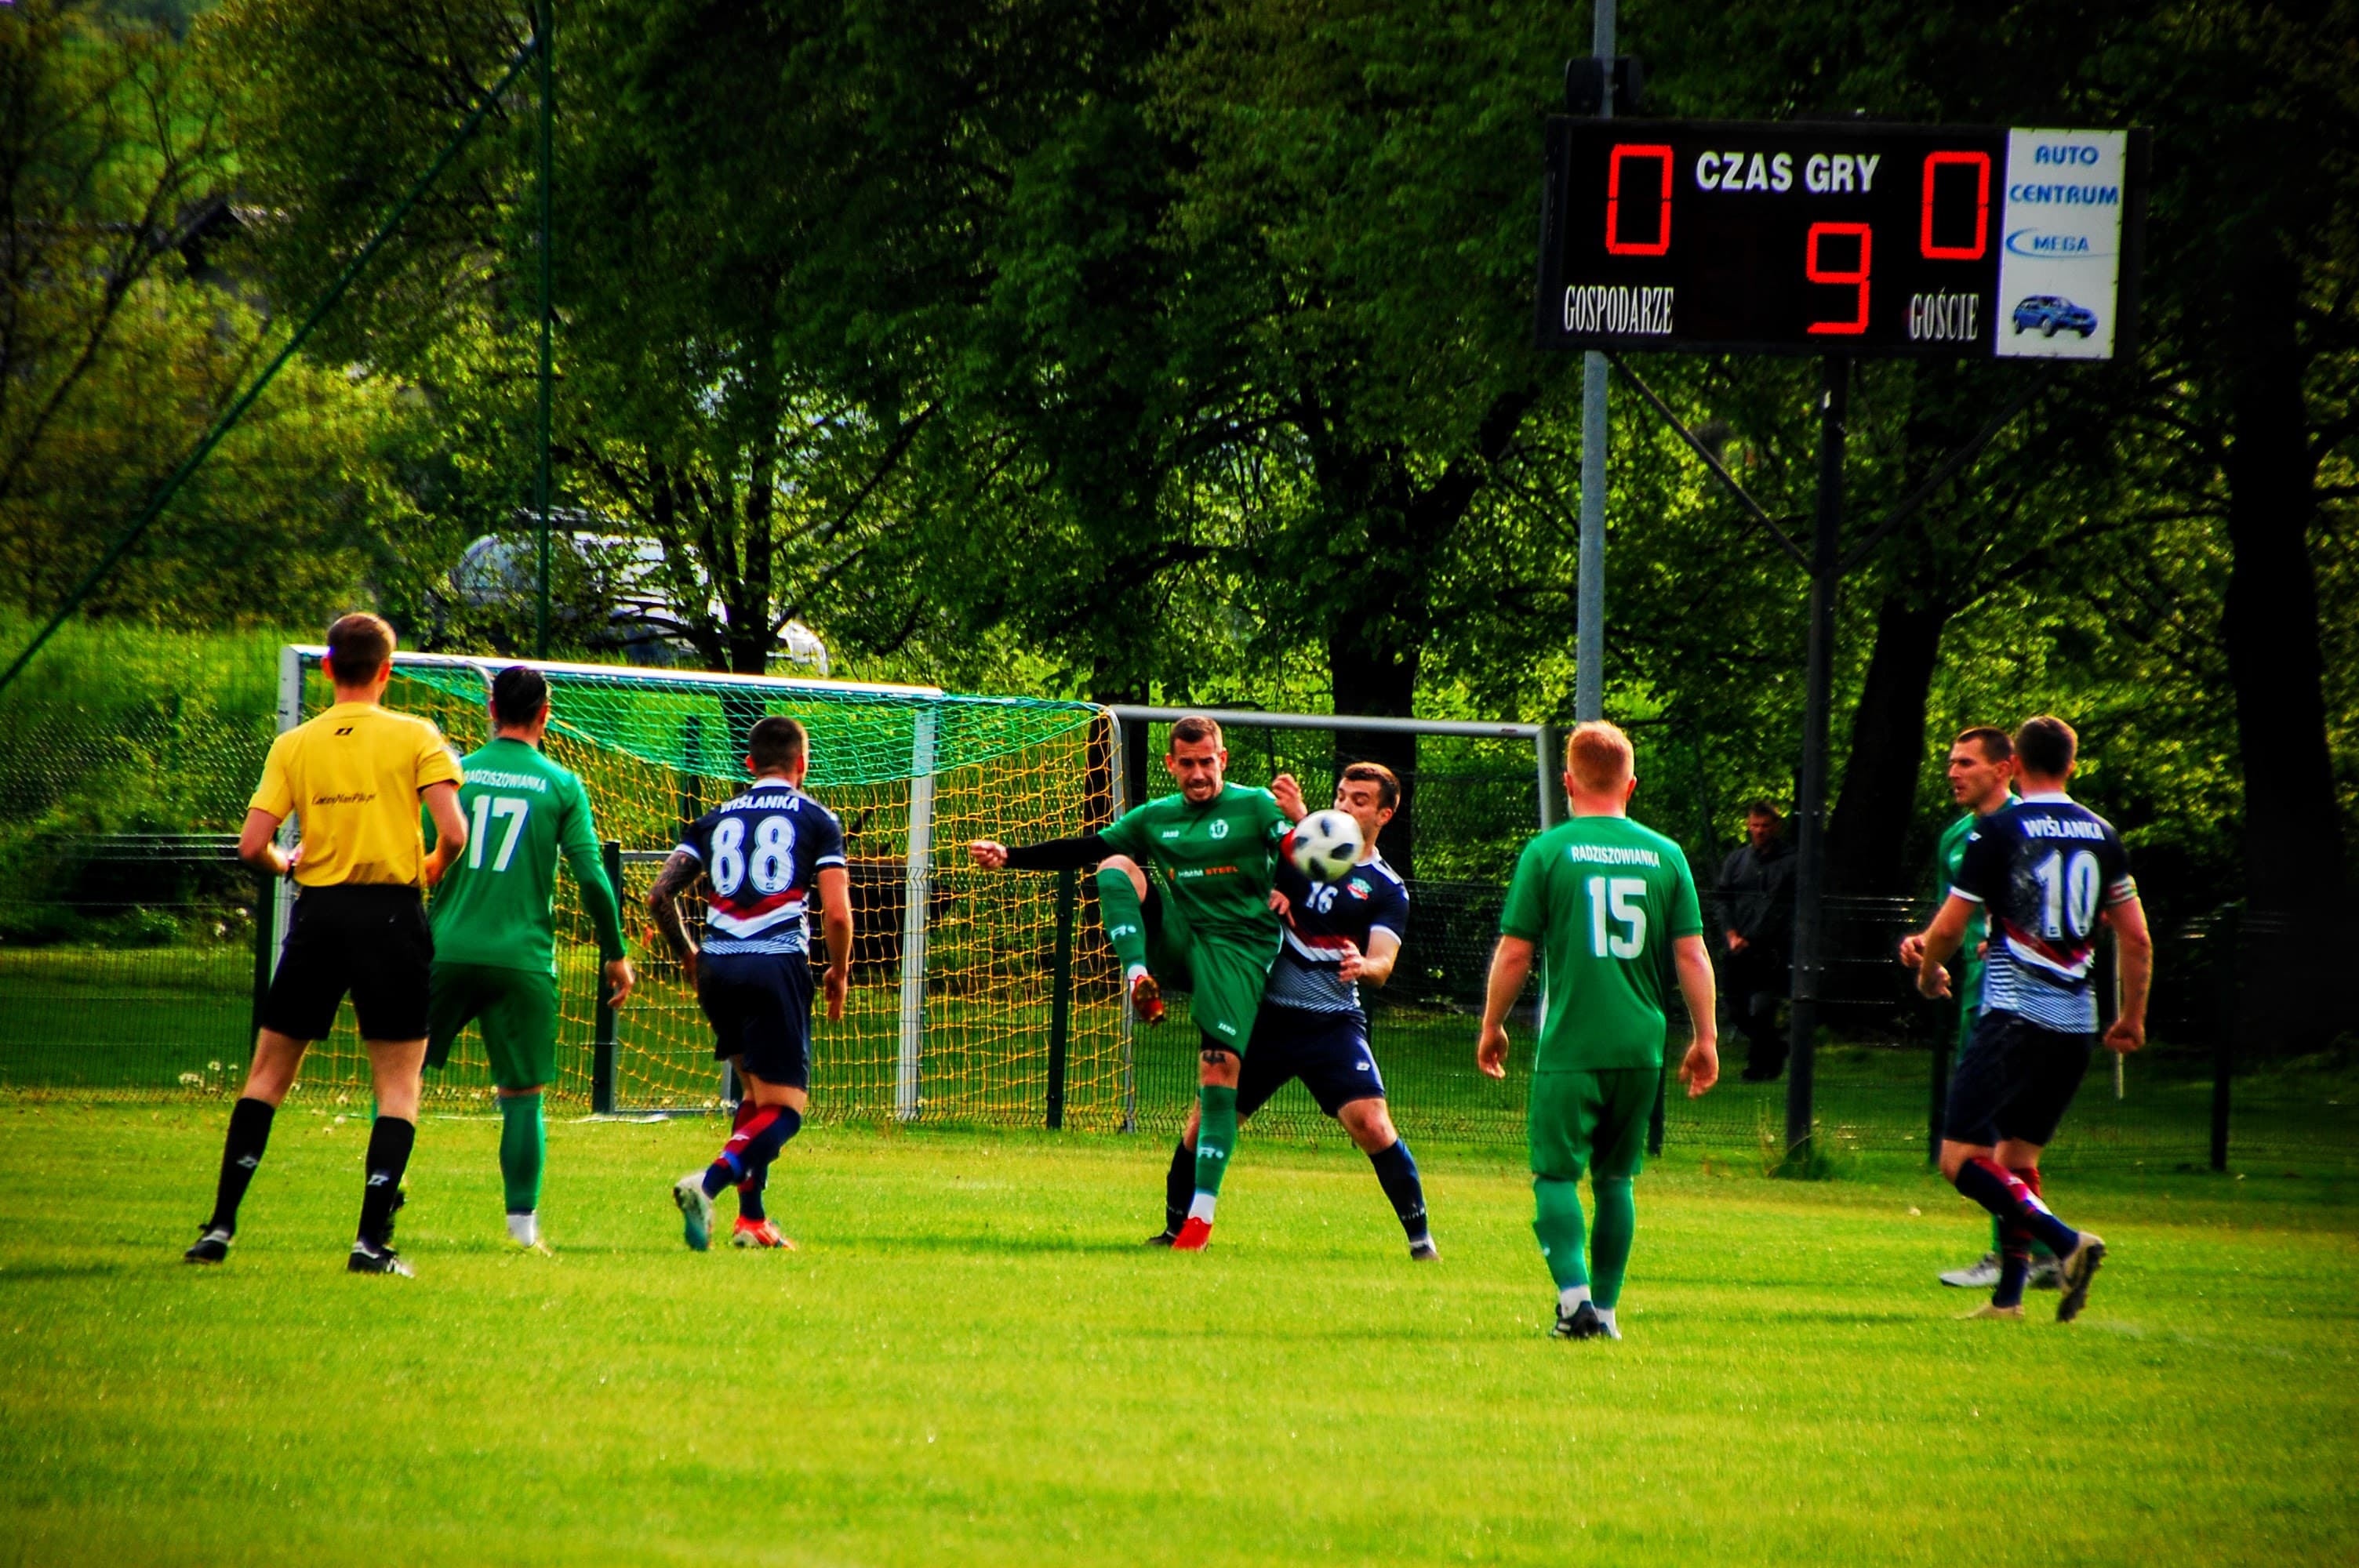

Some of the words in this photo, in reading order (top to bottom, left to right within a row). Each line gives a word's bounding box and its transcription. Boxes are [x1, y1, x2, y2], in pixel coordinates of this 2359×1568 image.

[1696, 151, 1793, 192] CZAS
[1805, 153, 1881, 193] GRY
[2034, 145, 2099, 165] AUTO
[1606, 143, 1674, 256] 0
[1921, 151, 1990, 260] 0
[2009, 183, 2119, 205] CENTRUM
[2034, 237, 2089, 252] MEGA
[1806, 222, 1872, 334] 9
[1564, 285, 1674, 334] GOSPODARZE
[1910, 286, 1979, 341] GOŚCIE
[468, 794, 529, 872] 17
[2023, 815, 2106, 840] WIŚLANKA
[711, 815, 795, 897] 88
[1571, 845, 1660, 868] RADZISZOWIANKA
[1305, 881, 1339, 914] 16
[1589, 876, 1647, 959] 15
[2034, 849, 2100, 939] 10
